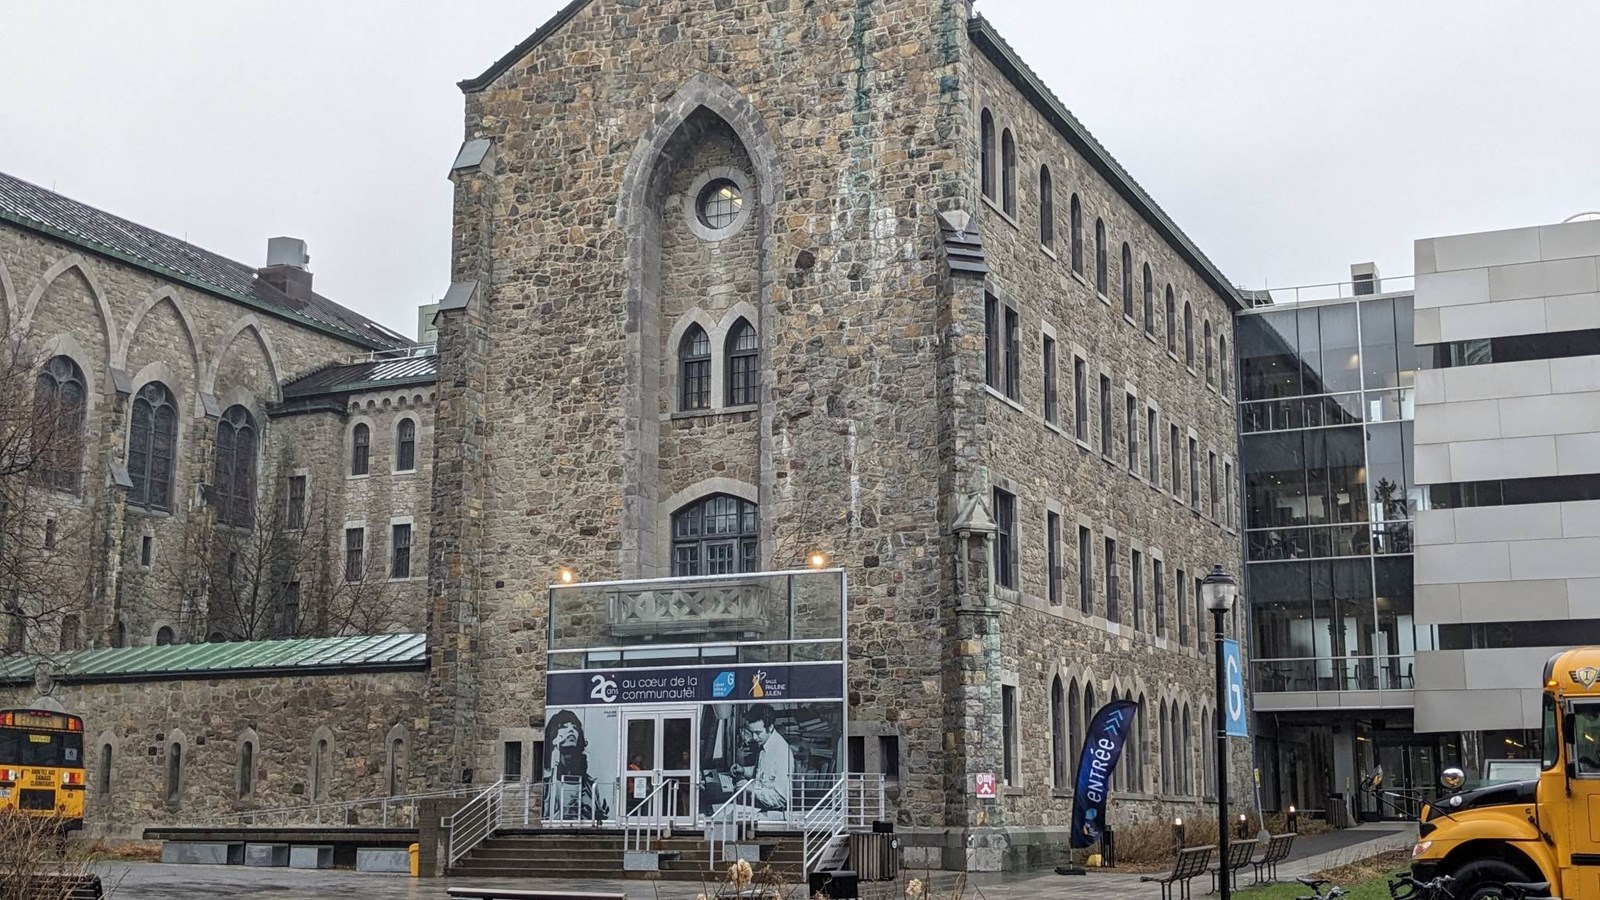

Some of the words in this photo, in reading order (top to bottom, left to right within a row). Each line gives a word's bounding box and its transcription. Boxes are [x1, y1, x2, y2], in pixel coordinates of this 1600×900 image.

[622, 680, 636, 689] au
[670, 676, 685, 687] de
[687, 676, 698, 686] la
[727, 673, 735, 686] G
[622, 687, 695, 700] communauté!
[1227, 655, 1242, 721] G
